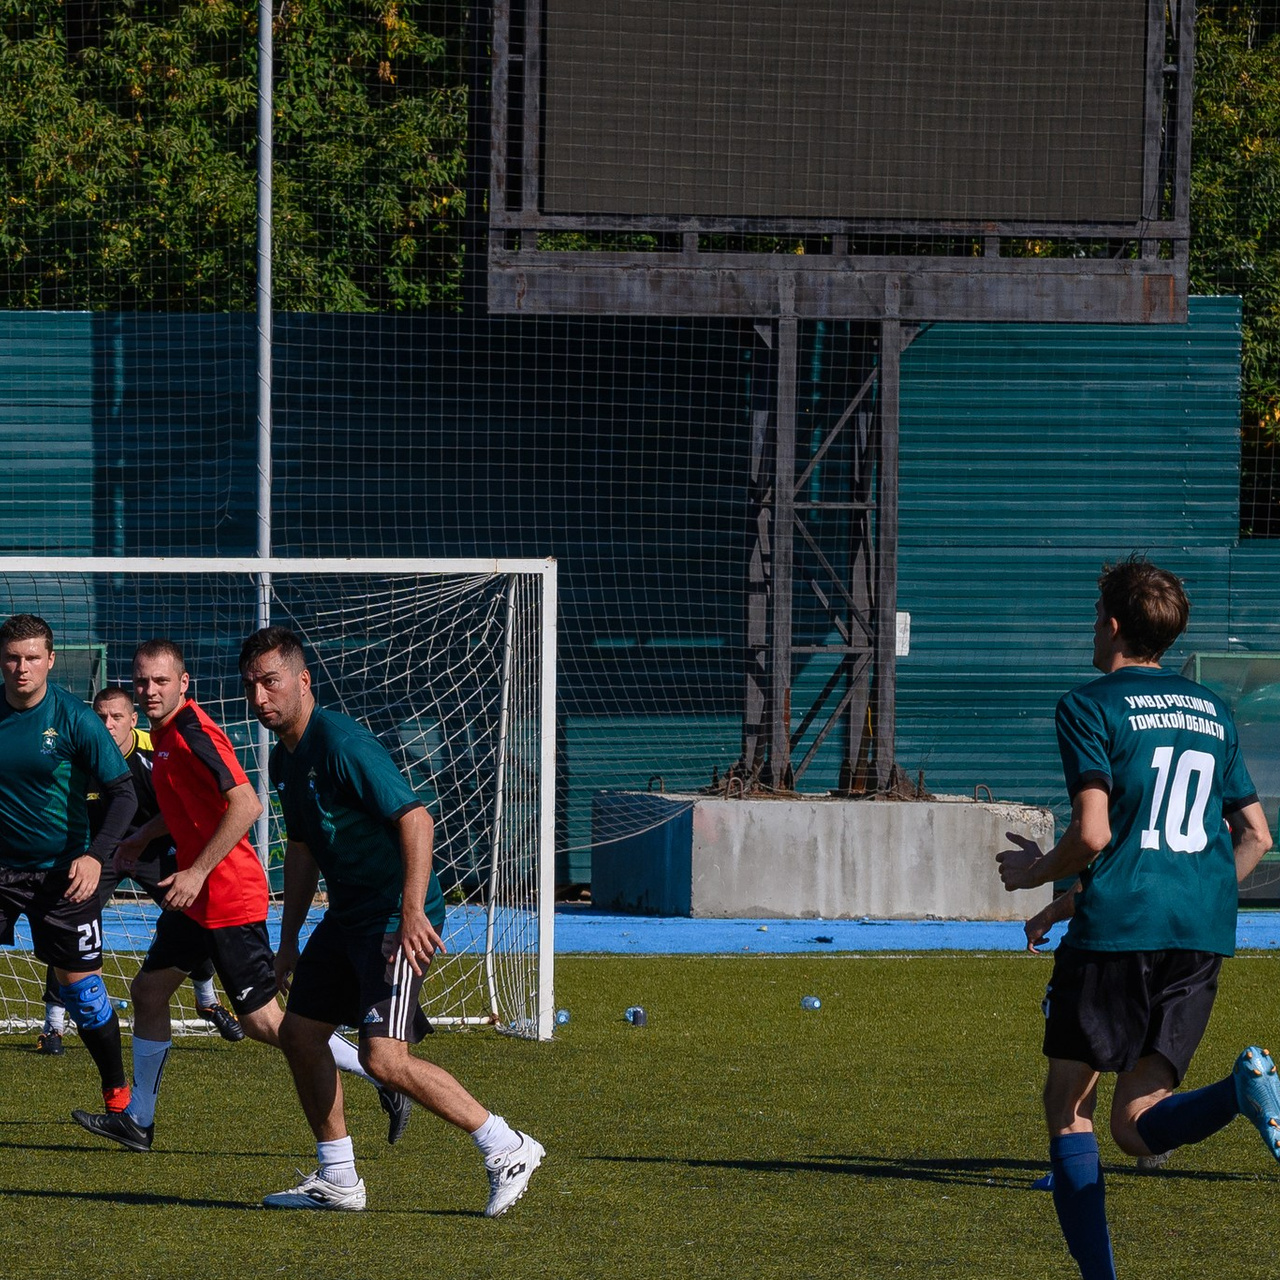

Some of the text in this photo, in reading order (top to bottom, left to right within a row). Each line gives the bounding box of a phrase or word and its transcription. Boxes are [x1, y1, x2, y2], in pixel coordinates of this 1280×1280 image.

[1124, 694, 1217, 717] УМВД РОССИИ ПО
[1128, 710, 1224, 741] ТОМСКОЙ ОБЛАСТИ
[1140, 746, 1216, 853] 10
[77, 919, 101, 951] 21
